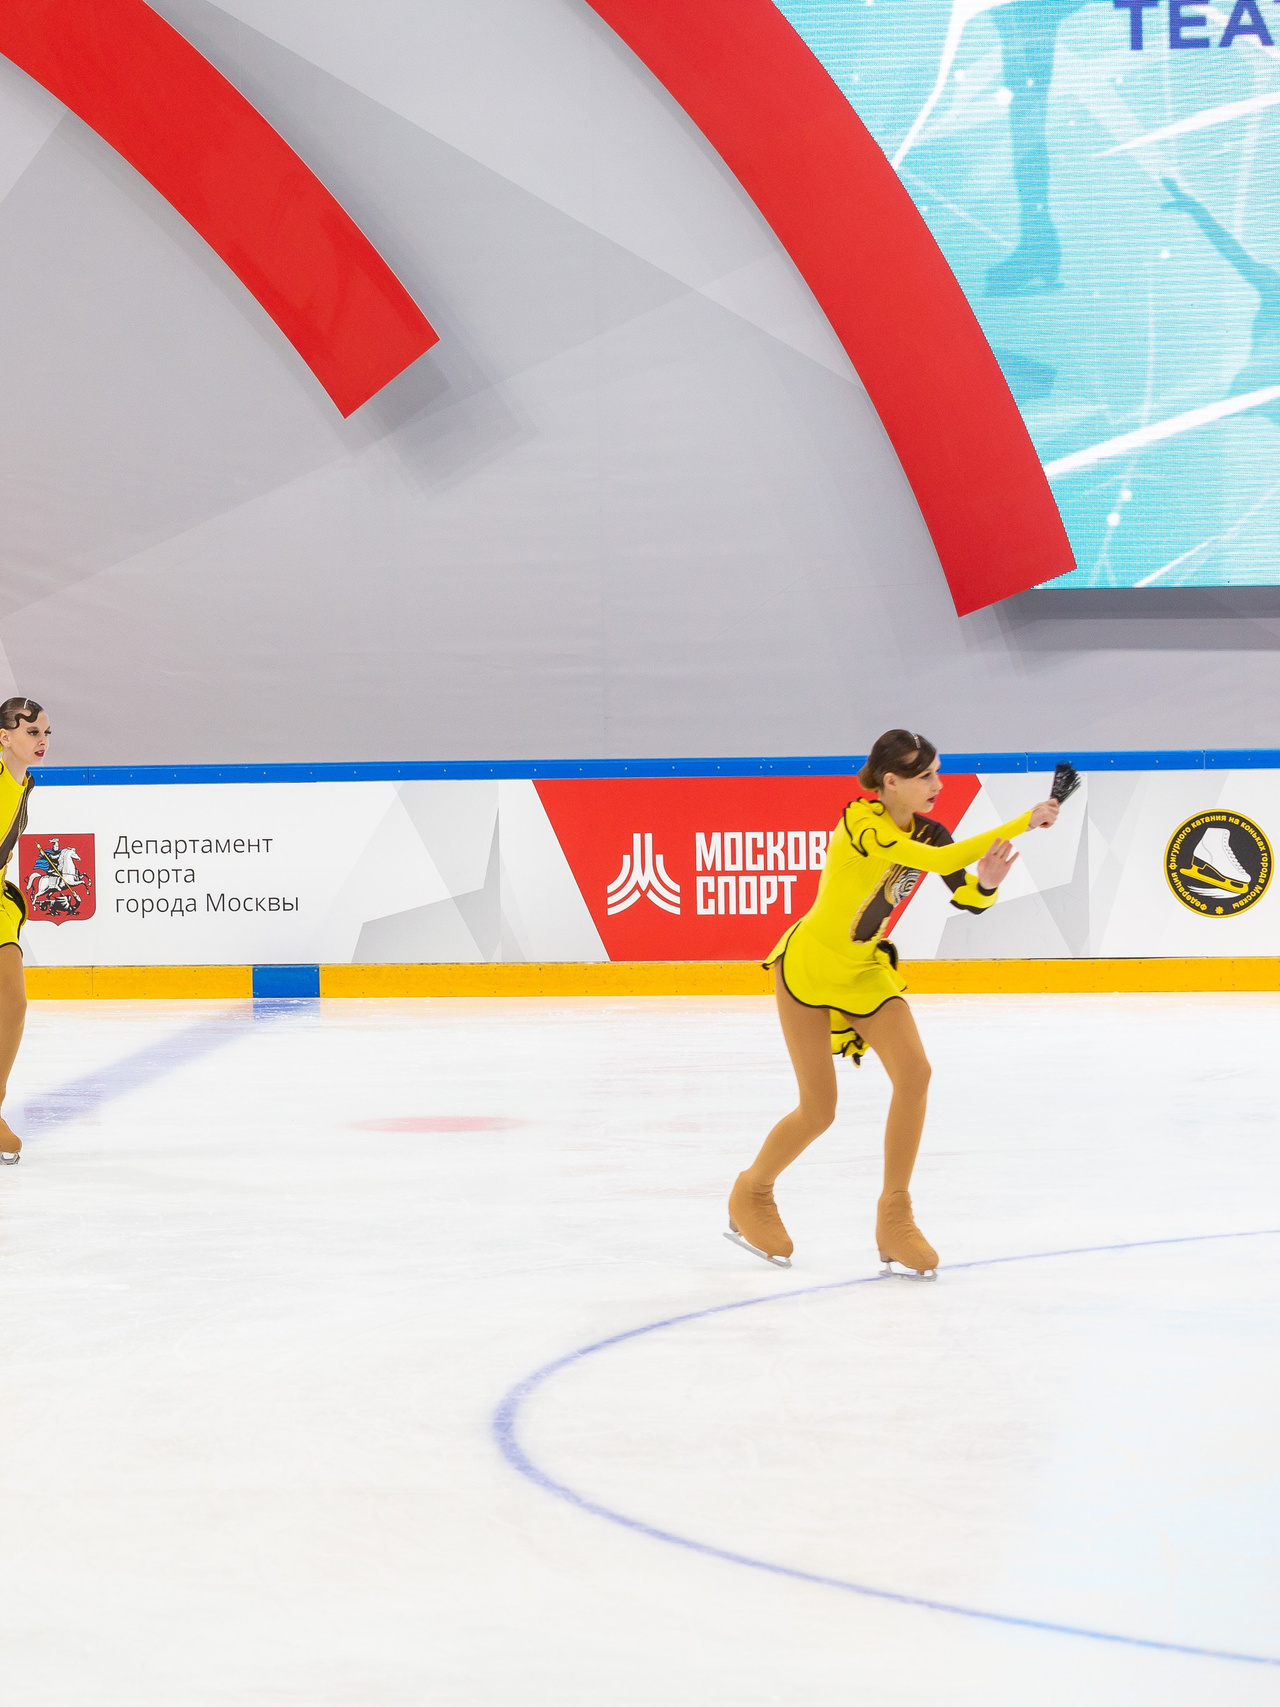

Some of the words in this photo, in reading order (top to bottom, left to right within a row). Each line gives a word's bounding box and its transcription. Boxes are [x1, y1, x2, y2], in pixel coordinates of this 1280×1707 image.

[1191, 815, 1227, 829] катания
[1228, 816, 1240, 825] на
[113, 835, 273, 860] Департамент
[1168, 826, 1191, 870] фигурного
[1240, 822, 1266, 852] коньках
[695, 831, 835, 872] МОСКОВ
[114, 867, 196, 888] спорта
[1260, 852, 1269, 884] города
[696, 875, 798, 915] СПОРТ
[1171, 872, 1208, 911] Федерация
[1231, 885, 1263, 909] Москвы
[115, 896, 197, 918] города
[206, 893, 299, 912] Москвы
